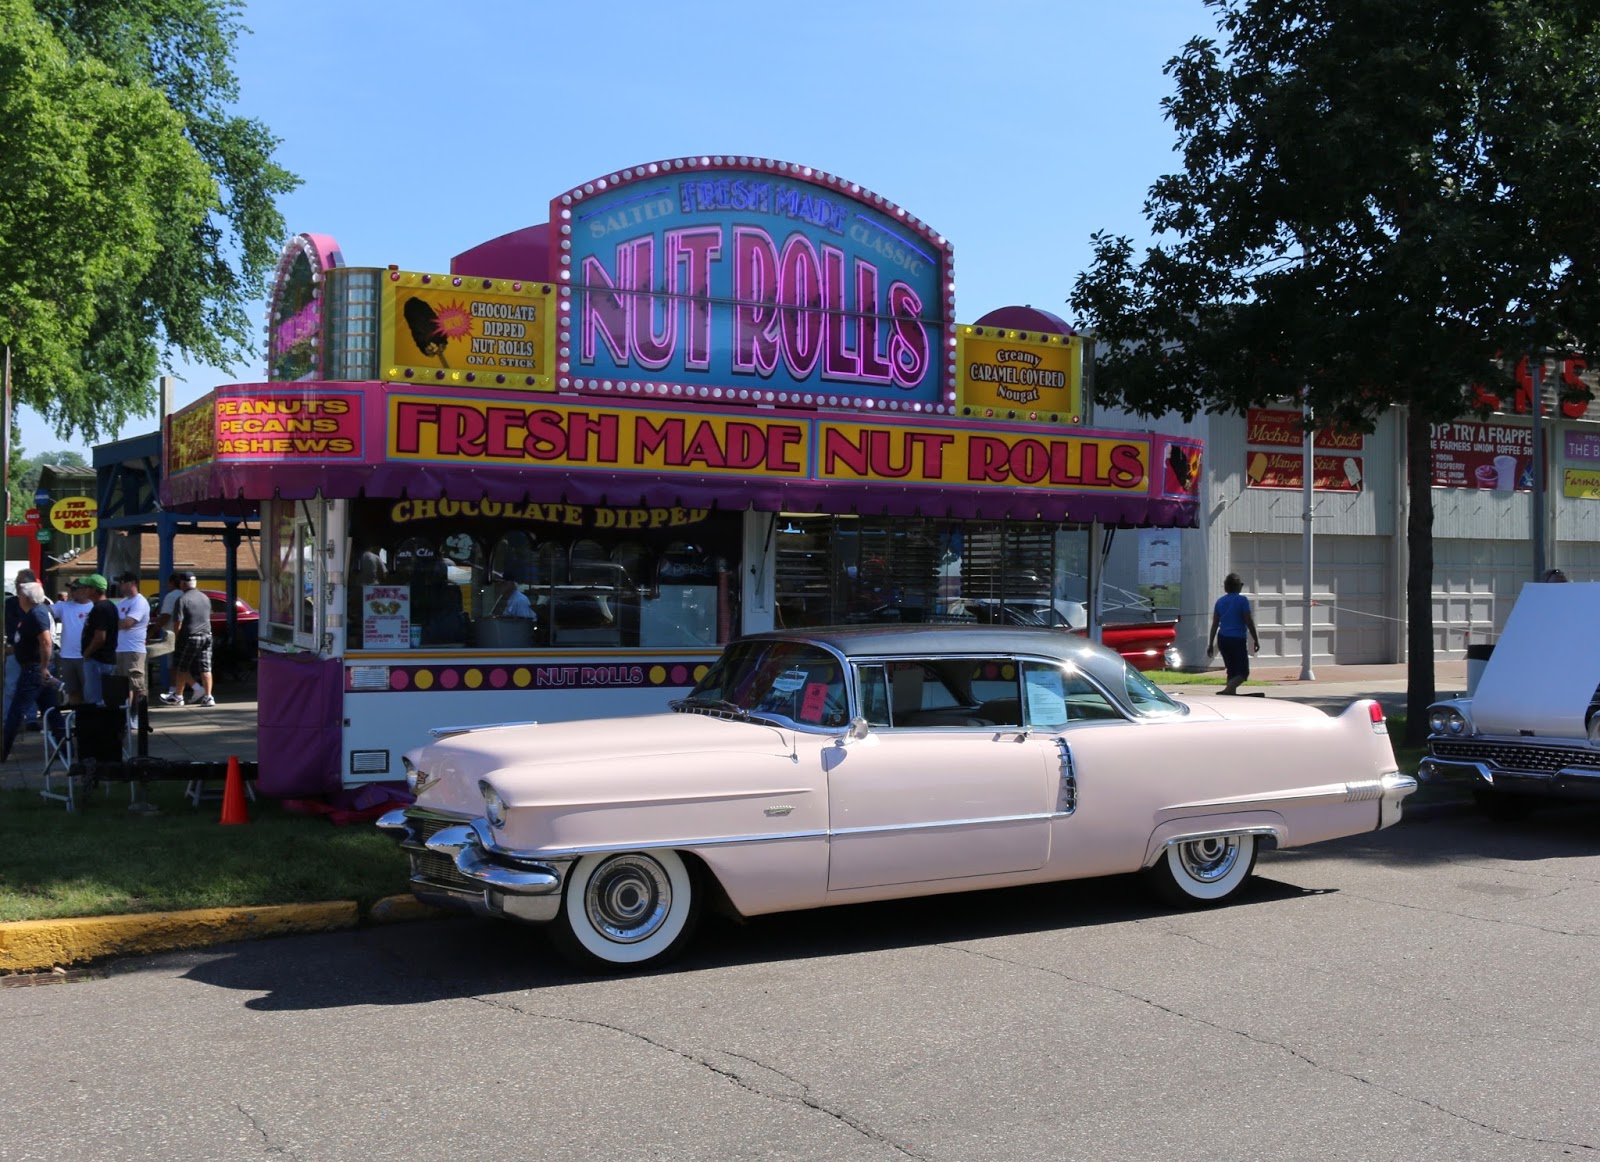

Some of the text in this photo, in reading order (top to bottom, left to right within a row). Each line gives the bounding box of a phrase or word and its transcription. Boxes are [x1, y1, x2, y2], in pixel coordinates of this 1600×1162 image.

[680, 178, 848, 236] FRESH MADE
[590, 198, 674, 239] SALTED
[850, 224, 924, 278] CLASSIC
[471, 301, 536, 321] CHOCOLATE
[579, 223, 931, 390] NUT ROLLS
[483, 321, 526, 338] DIPPED
[471, 337, 534, 356] NUT ROLLS
[467, 355, 536, 368] ON A STICK
[996, 349, 1043, 368] Creamy
[970, 363, 1066, 389] CARAMEL COVERED
[996, 385, 1040, 403] Nougat
[217, 400, 350, 416] PEANUTS
[220, 418, 338, 434] PECANS
[1248, 424, 1290, 442] Mocha
[1327, 430, 1361, 447] Stick
[1453, 424, 1476, 442] TRY
[1478, 427, 1486, 442] A
[1488, 427, 1532, 445] FRAPPE
[216, 438, 354, 454] CASHEWS
[396, 401, 803, 473] FRESH MADE
[825, 427, 1145, 488] NUT ROLLS
[1440, 441, 1471, 451] FARMERS
[1473, 443, 1494, 453] UNION
[1497, 445, 1521, 455] COFFEE
[1569, 442, 1590, 457] THE
[1268, 455, 1338, 471] Mango Stick
[1436, 462, 1465, 470] RASPBERRY
[1448, 471, 1464, 479] UNION
[391, 498, 709, 530] CHOCOLATE DIPPED
[64, 519, 91, 529] BOX
[536, 666, 644, 686] NUT ROLLS
